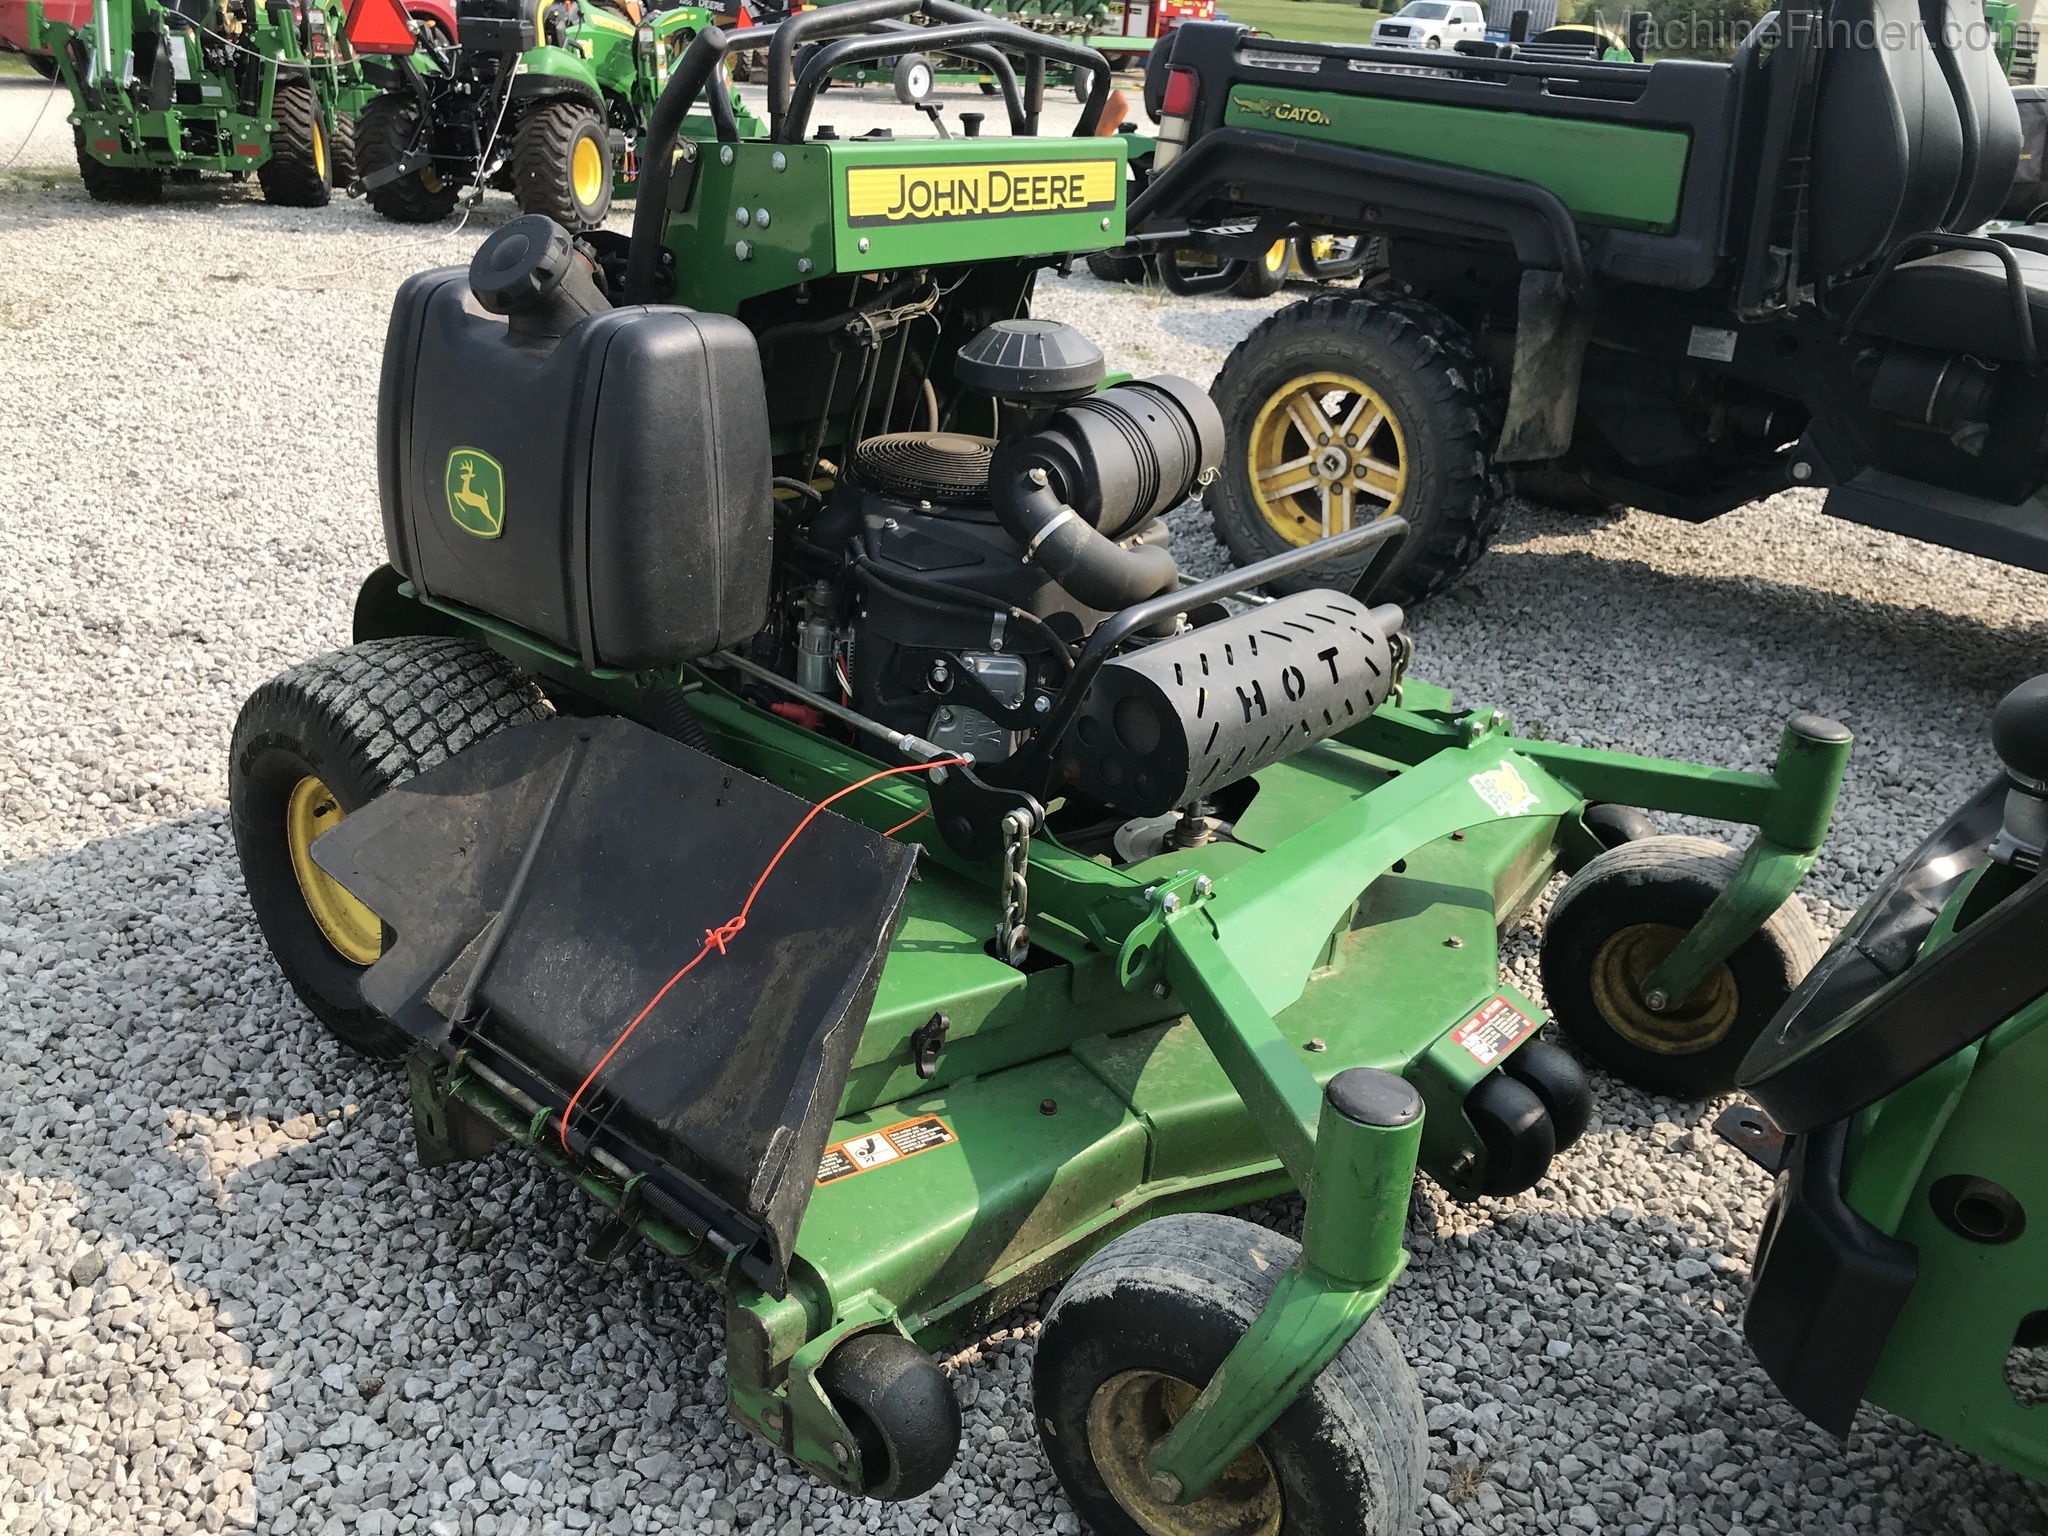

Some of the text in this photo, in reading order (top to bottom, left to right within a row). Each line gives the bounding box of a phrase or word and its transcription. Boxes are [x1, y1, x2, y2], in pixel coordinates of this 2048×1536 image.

[887, 170, 1085, 214] JOHN DEERE
[1235, 646, 1339, 724] HOT
[1487, 790, 1513, 811] Pro
